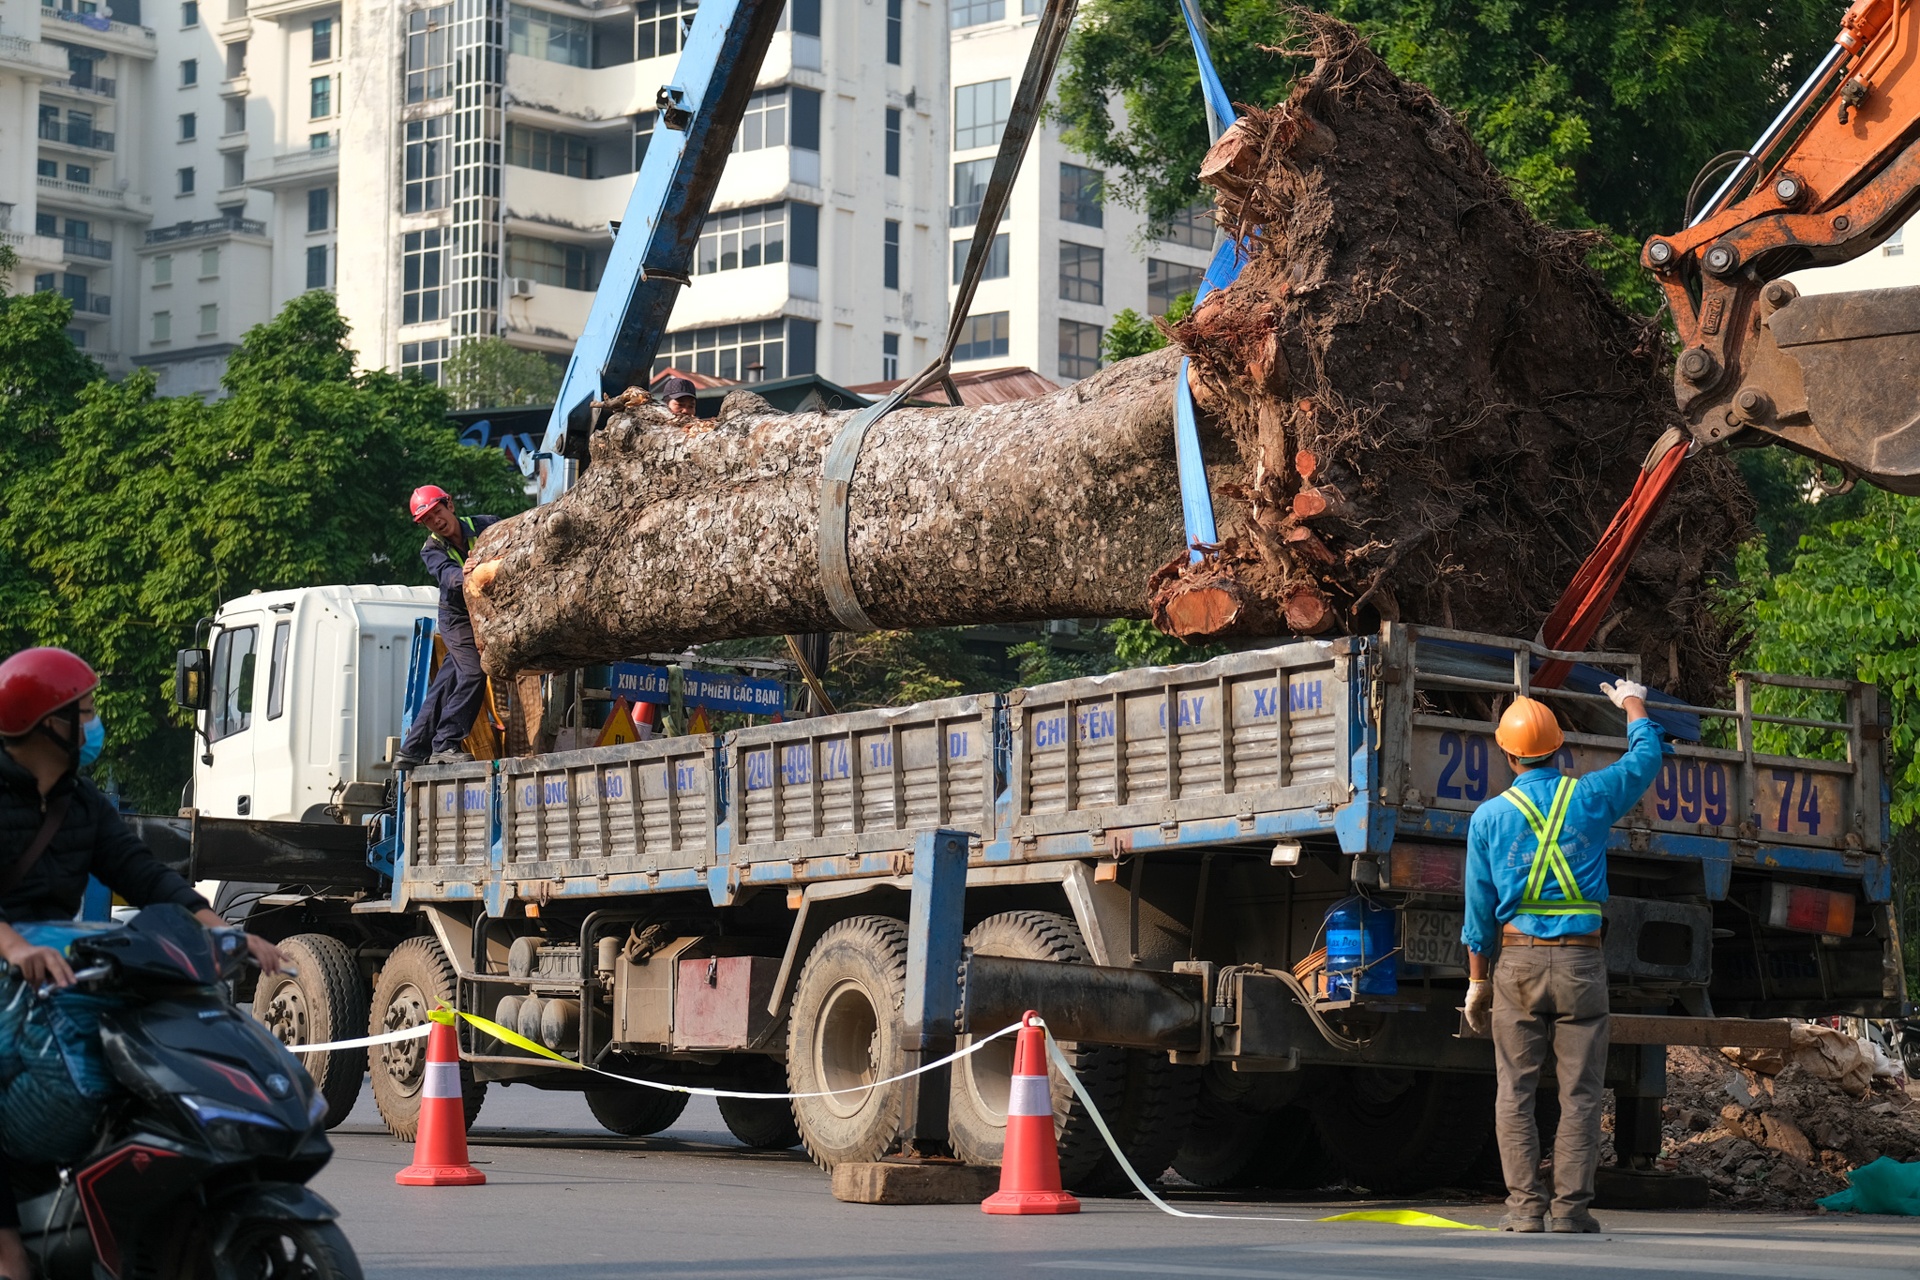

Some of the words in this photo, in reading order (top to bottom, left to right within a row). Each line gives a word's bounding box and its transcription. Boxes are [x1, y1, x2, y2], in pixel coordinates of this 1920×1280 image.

[618, 674, 637, 690] XIN
[682, 677, 698, 697] ÀM
[733, 684, 752, 703] CÁC
[755, 688, 780, 706] BẠN!
[1253, 680, 1323, 718] XANH
[1437, 730, 1488, 801] 29
[1655, 757, 1727, 826] 999
[1418, 912, 1452, 938] 29C
[1408, 937, 1467, 965] 999.74
